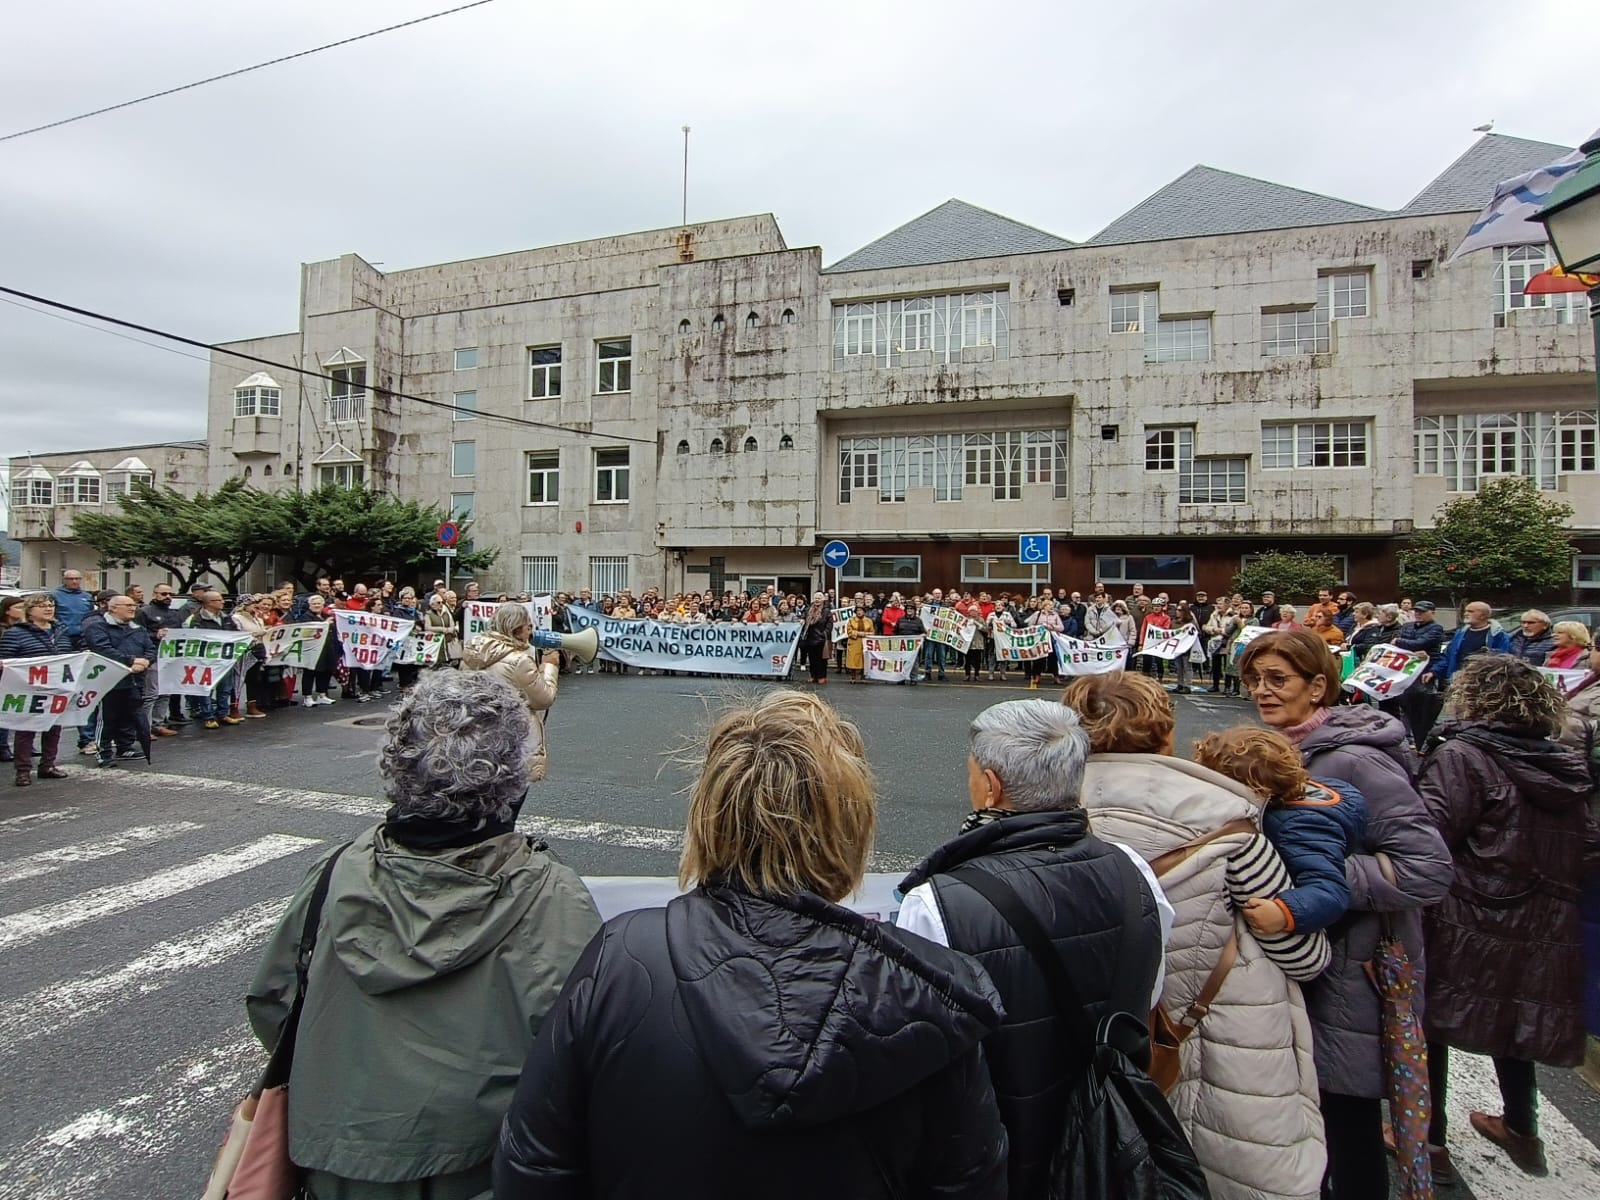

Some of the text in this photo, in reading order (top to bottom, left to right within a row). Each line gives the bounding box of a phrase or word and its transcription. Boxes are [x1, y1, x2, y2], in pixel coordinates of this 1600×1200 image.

[604, 621, 646, 636] UNHA
[650, 625, 726, 641] ATENCIÓN
[731, 630, 797, 644] PRIMARIA
[160, 639, 249, 662] MEDICOS
[604, 636, 764, 659] DIGNA NO BARBANZA
[28, 663, 107, 685] MAS
[181, 666, 213, 686] XA
